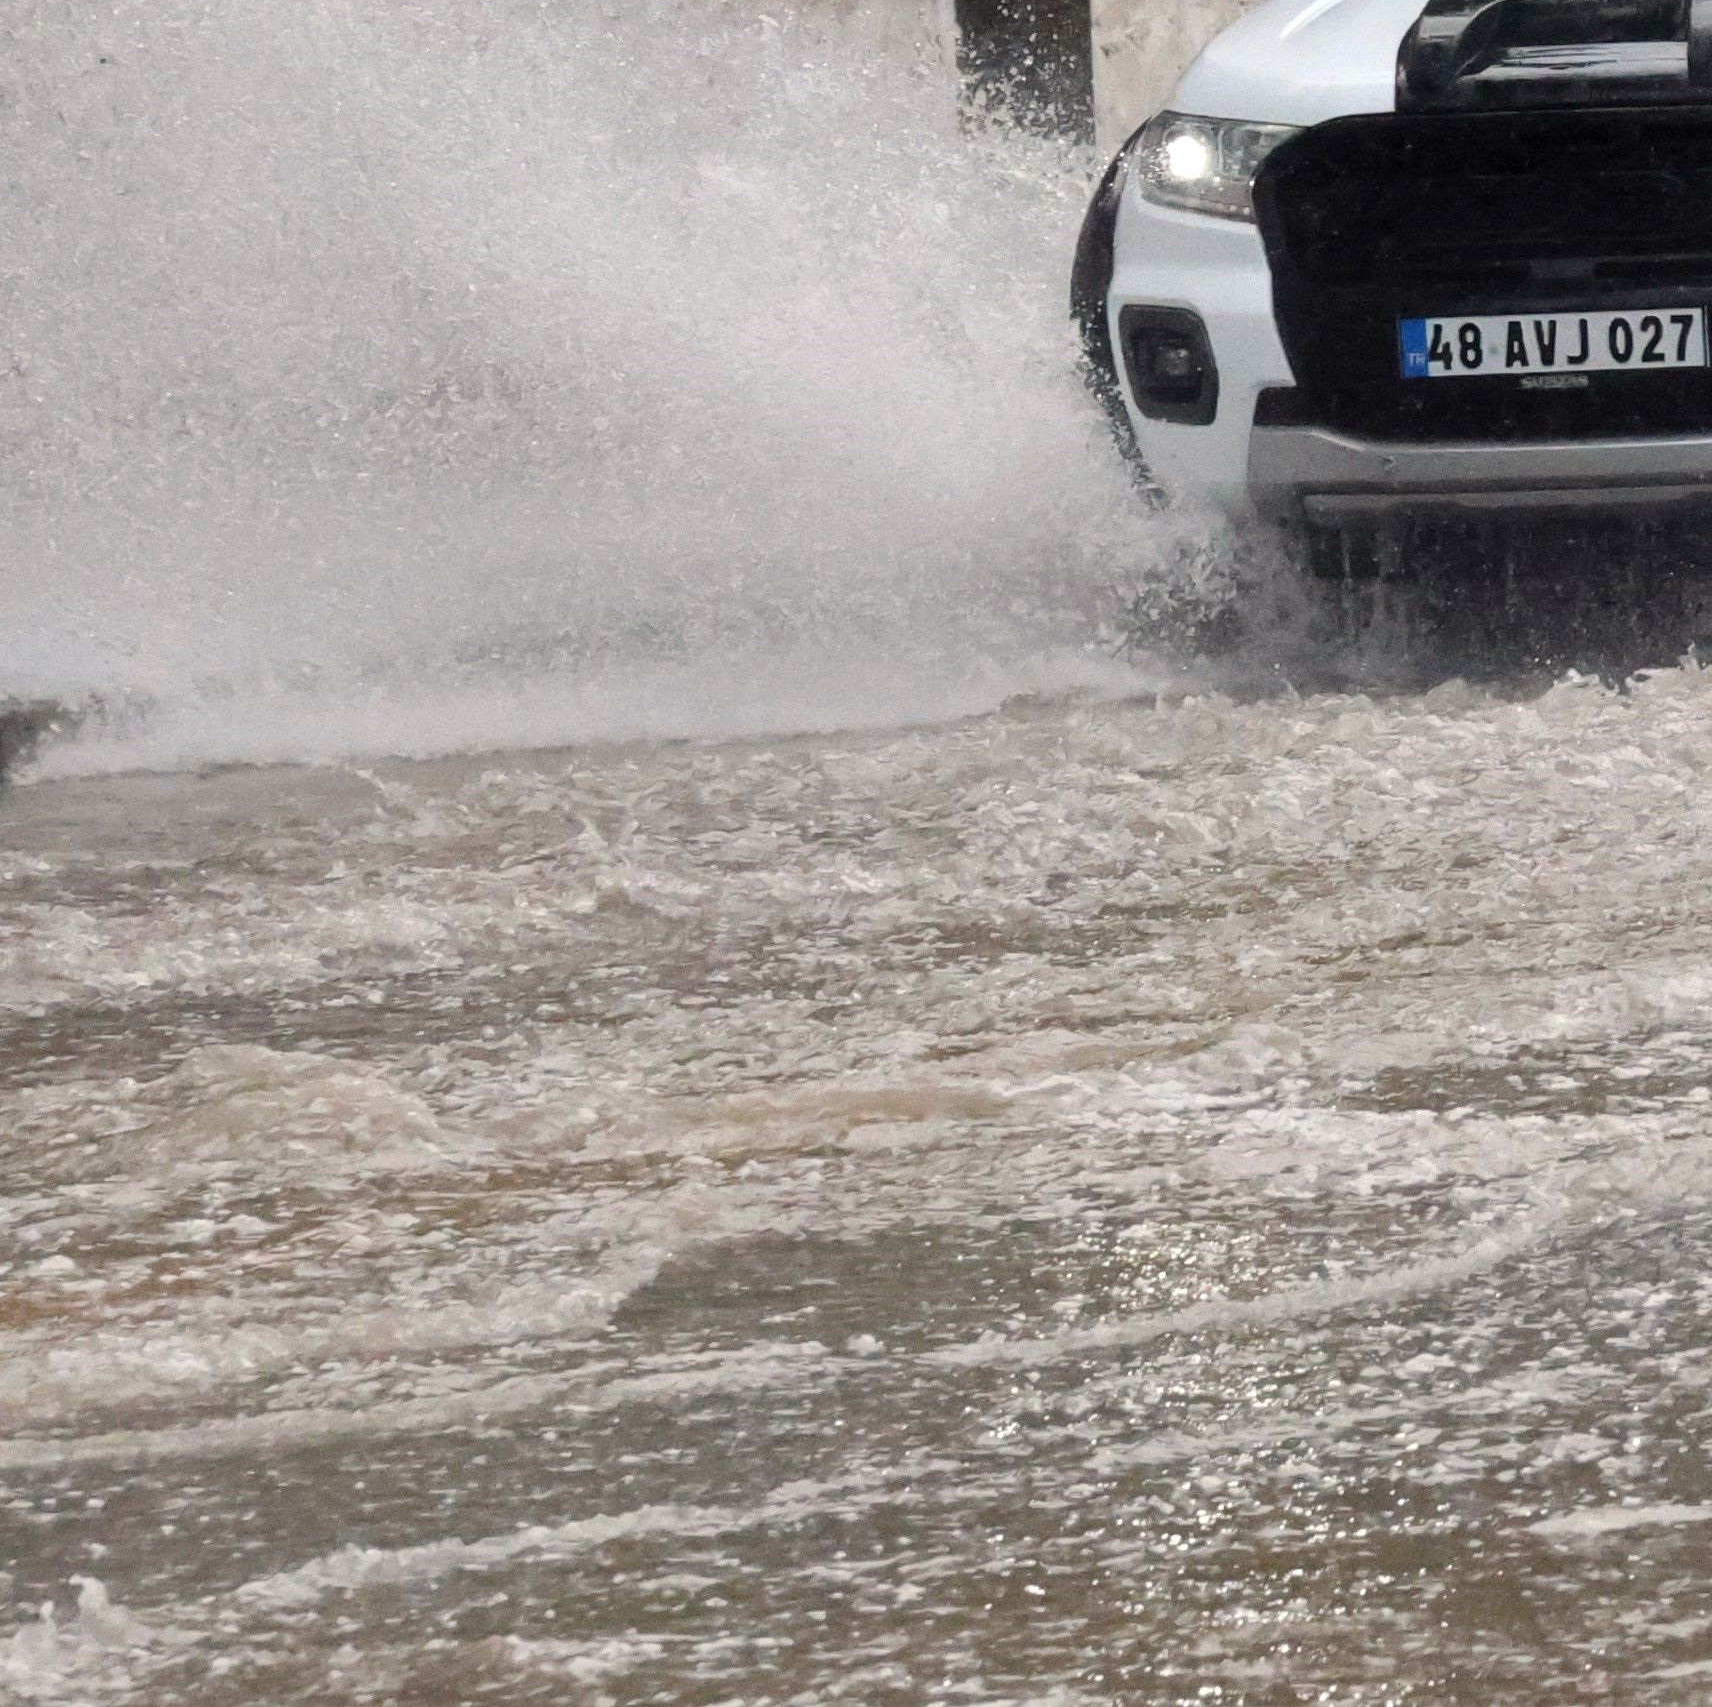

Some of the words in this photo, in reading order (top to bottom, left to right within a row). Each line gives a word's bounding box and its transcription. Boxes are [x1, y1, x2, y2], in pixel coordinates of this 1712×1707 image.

[1428, 322, 1483, 370] 48
[1505, 318, 1589, 368] AVJ
[1608, 314, 1694, 364] 027
